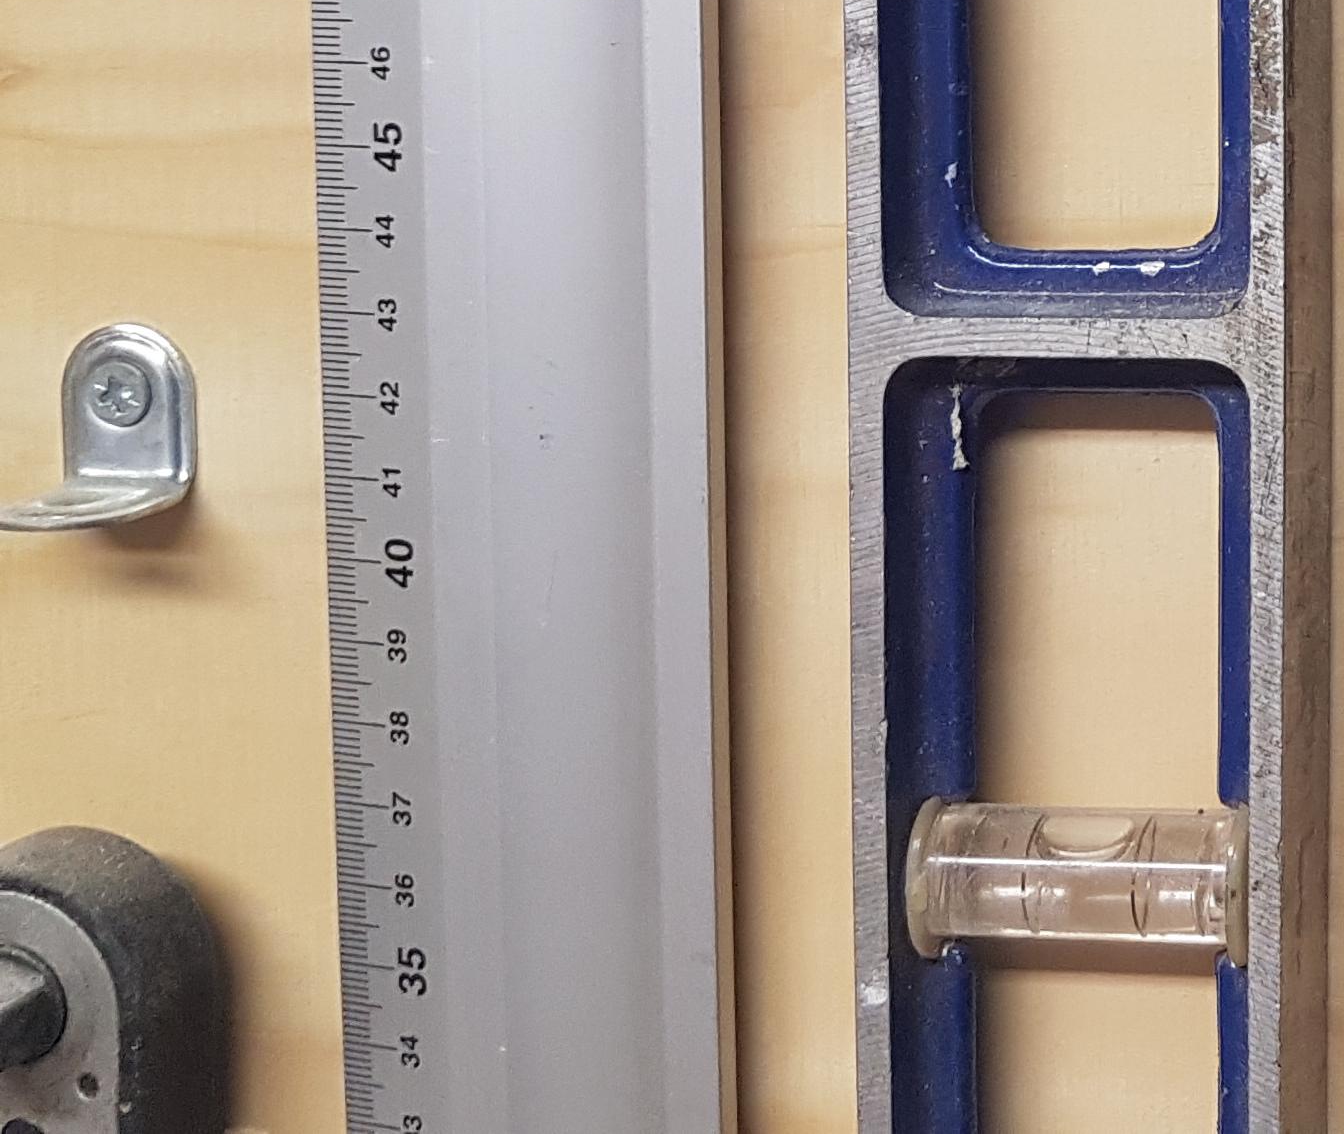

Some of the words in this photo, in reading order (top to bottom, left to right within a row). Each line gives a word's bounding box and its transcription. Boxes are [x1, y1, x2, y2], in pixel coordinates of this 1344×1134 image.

[371, 46, 390, 80] 46
[374, 122, 402, 172] 45
[376, 215, 394, 248] 44
[378, 299, 396, 332] 43
[380, 382, 399, 415] 42
[383, 469, 401, 498] 41
[385, 540, 414, 588] 40
[388, 629, 407, 663] 39
[390, 712, 409, 745] 38
[393, 792, 411, 826] 37
[396, 874, 414, 908] 36
[399, 948, 427, 997] 35
[402, 1036, 421, 1068] 34
[403, 1115, 422, 1134] 3
